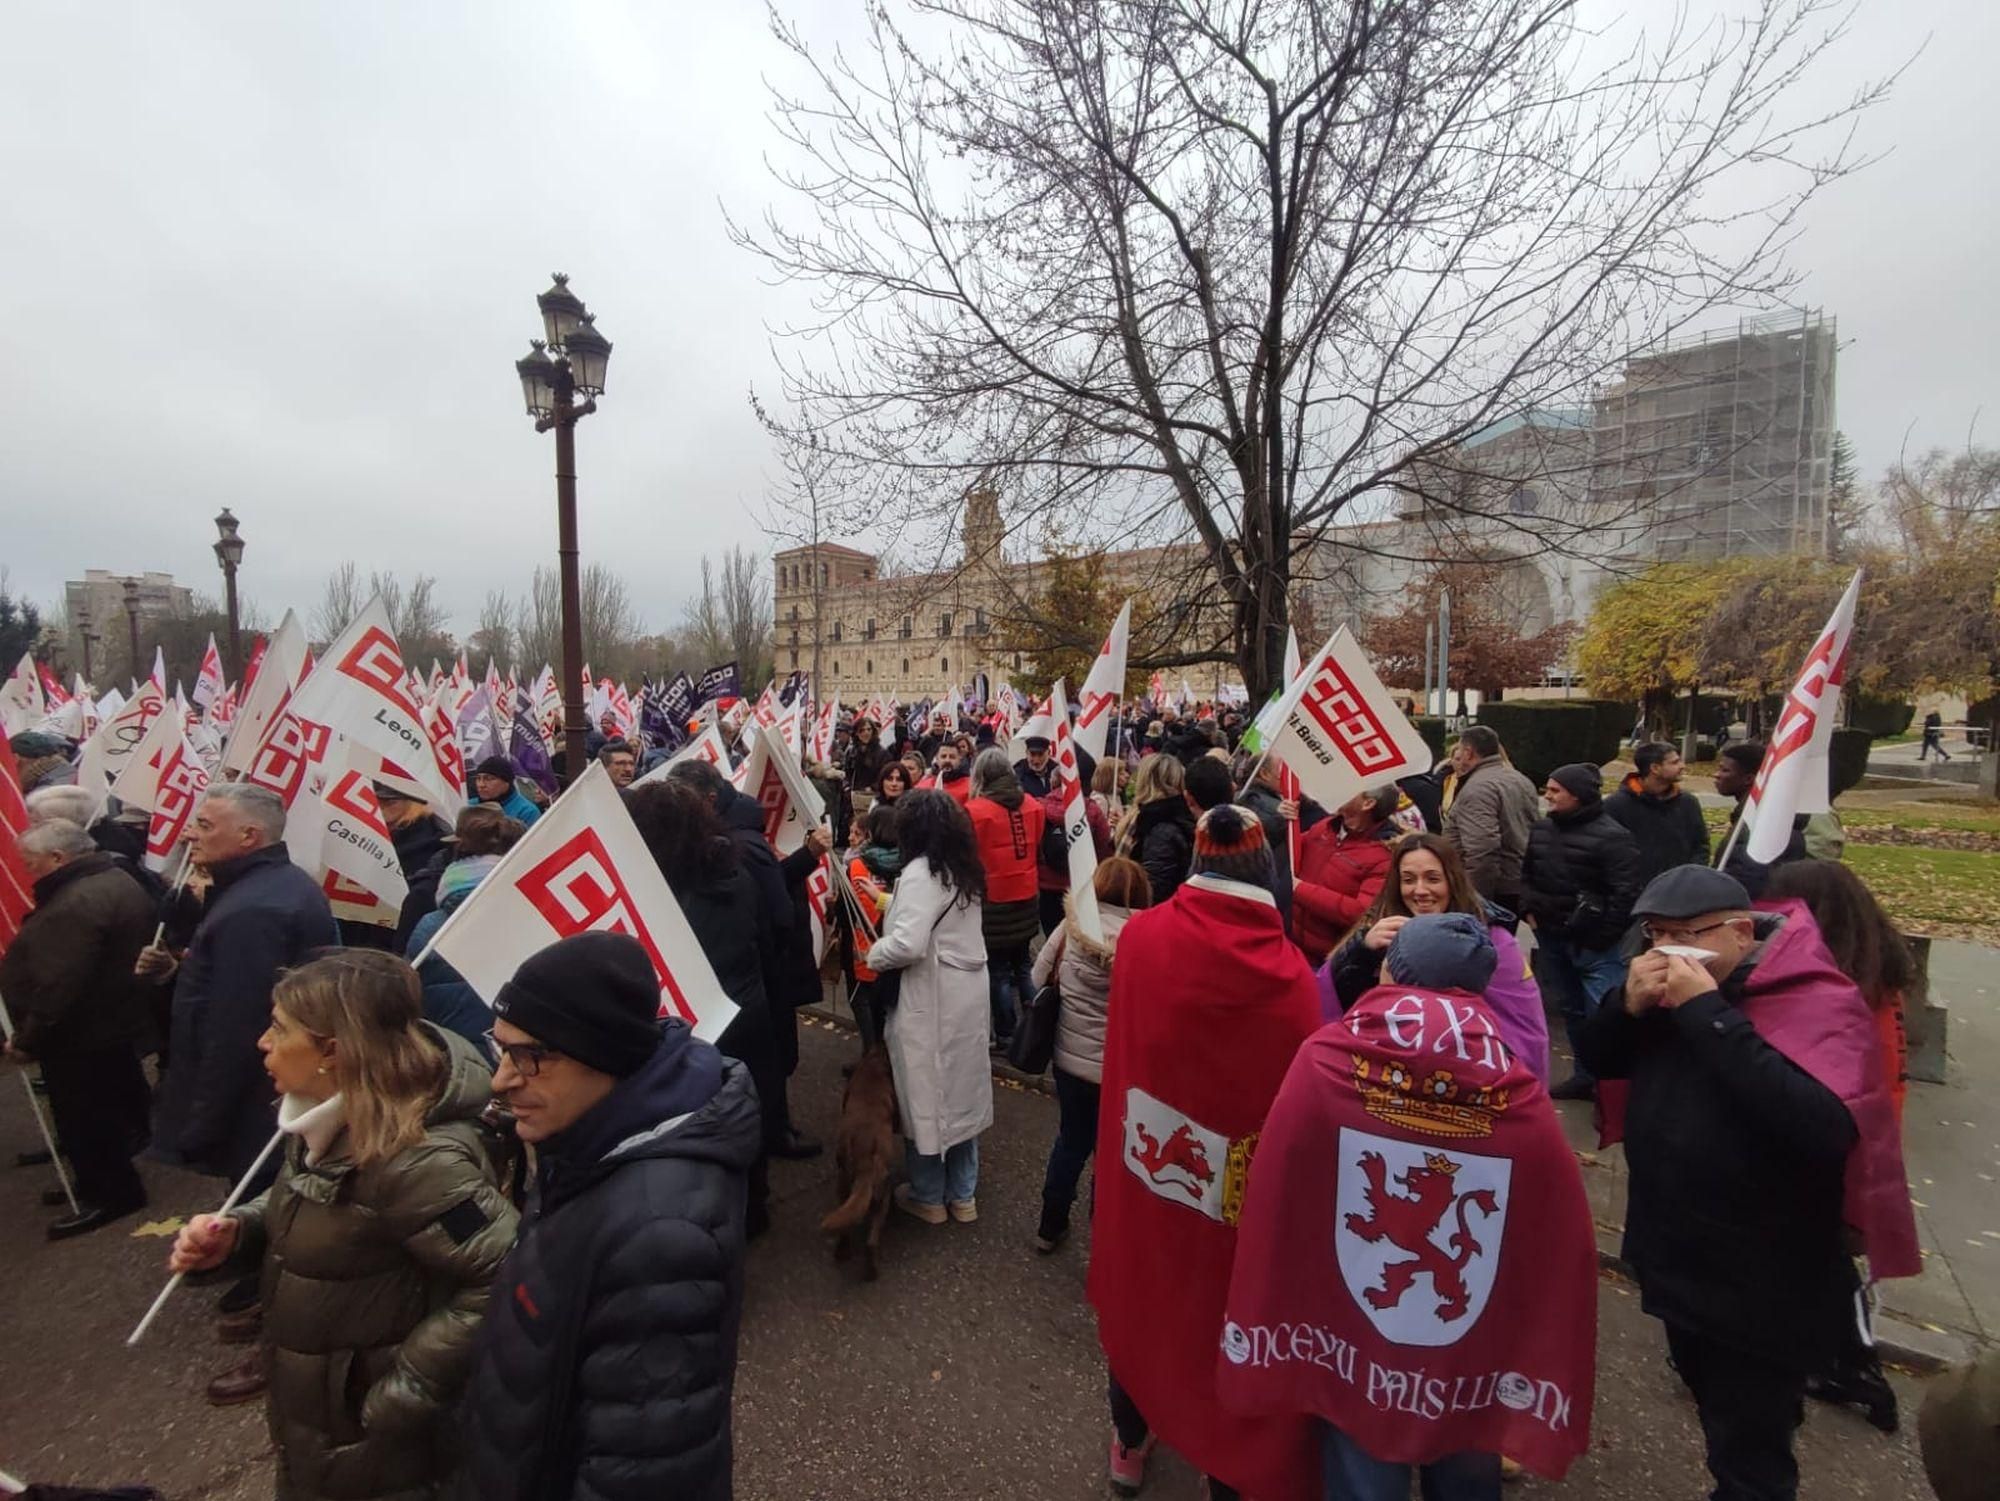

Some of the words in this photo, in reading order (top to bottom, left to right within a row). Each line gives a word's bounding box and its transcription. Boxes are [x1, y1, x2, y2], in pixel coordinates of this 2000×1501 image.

[373, 708, 423, 751] León
[1306, 668, 1394, 767] CCOO
[1296, 725, 1333, 765] Bierzo
[327, 819, 385, 860] Castilla
[383, 858, 396, 869] y
[1366, 1359, 1450, 1420] PAÍS
